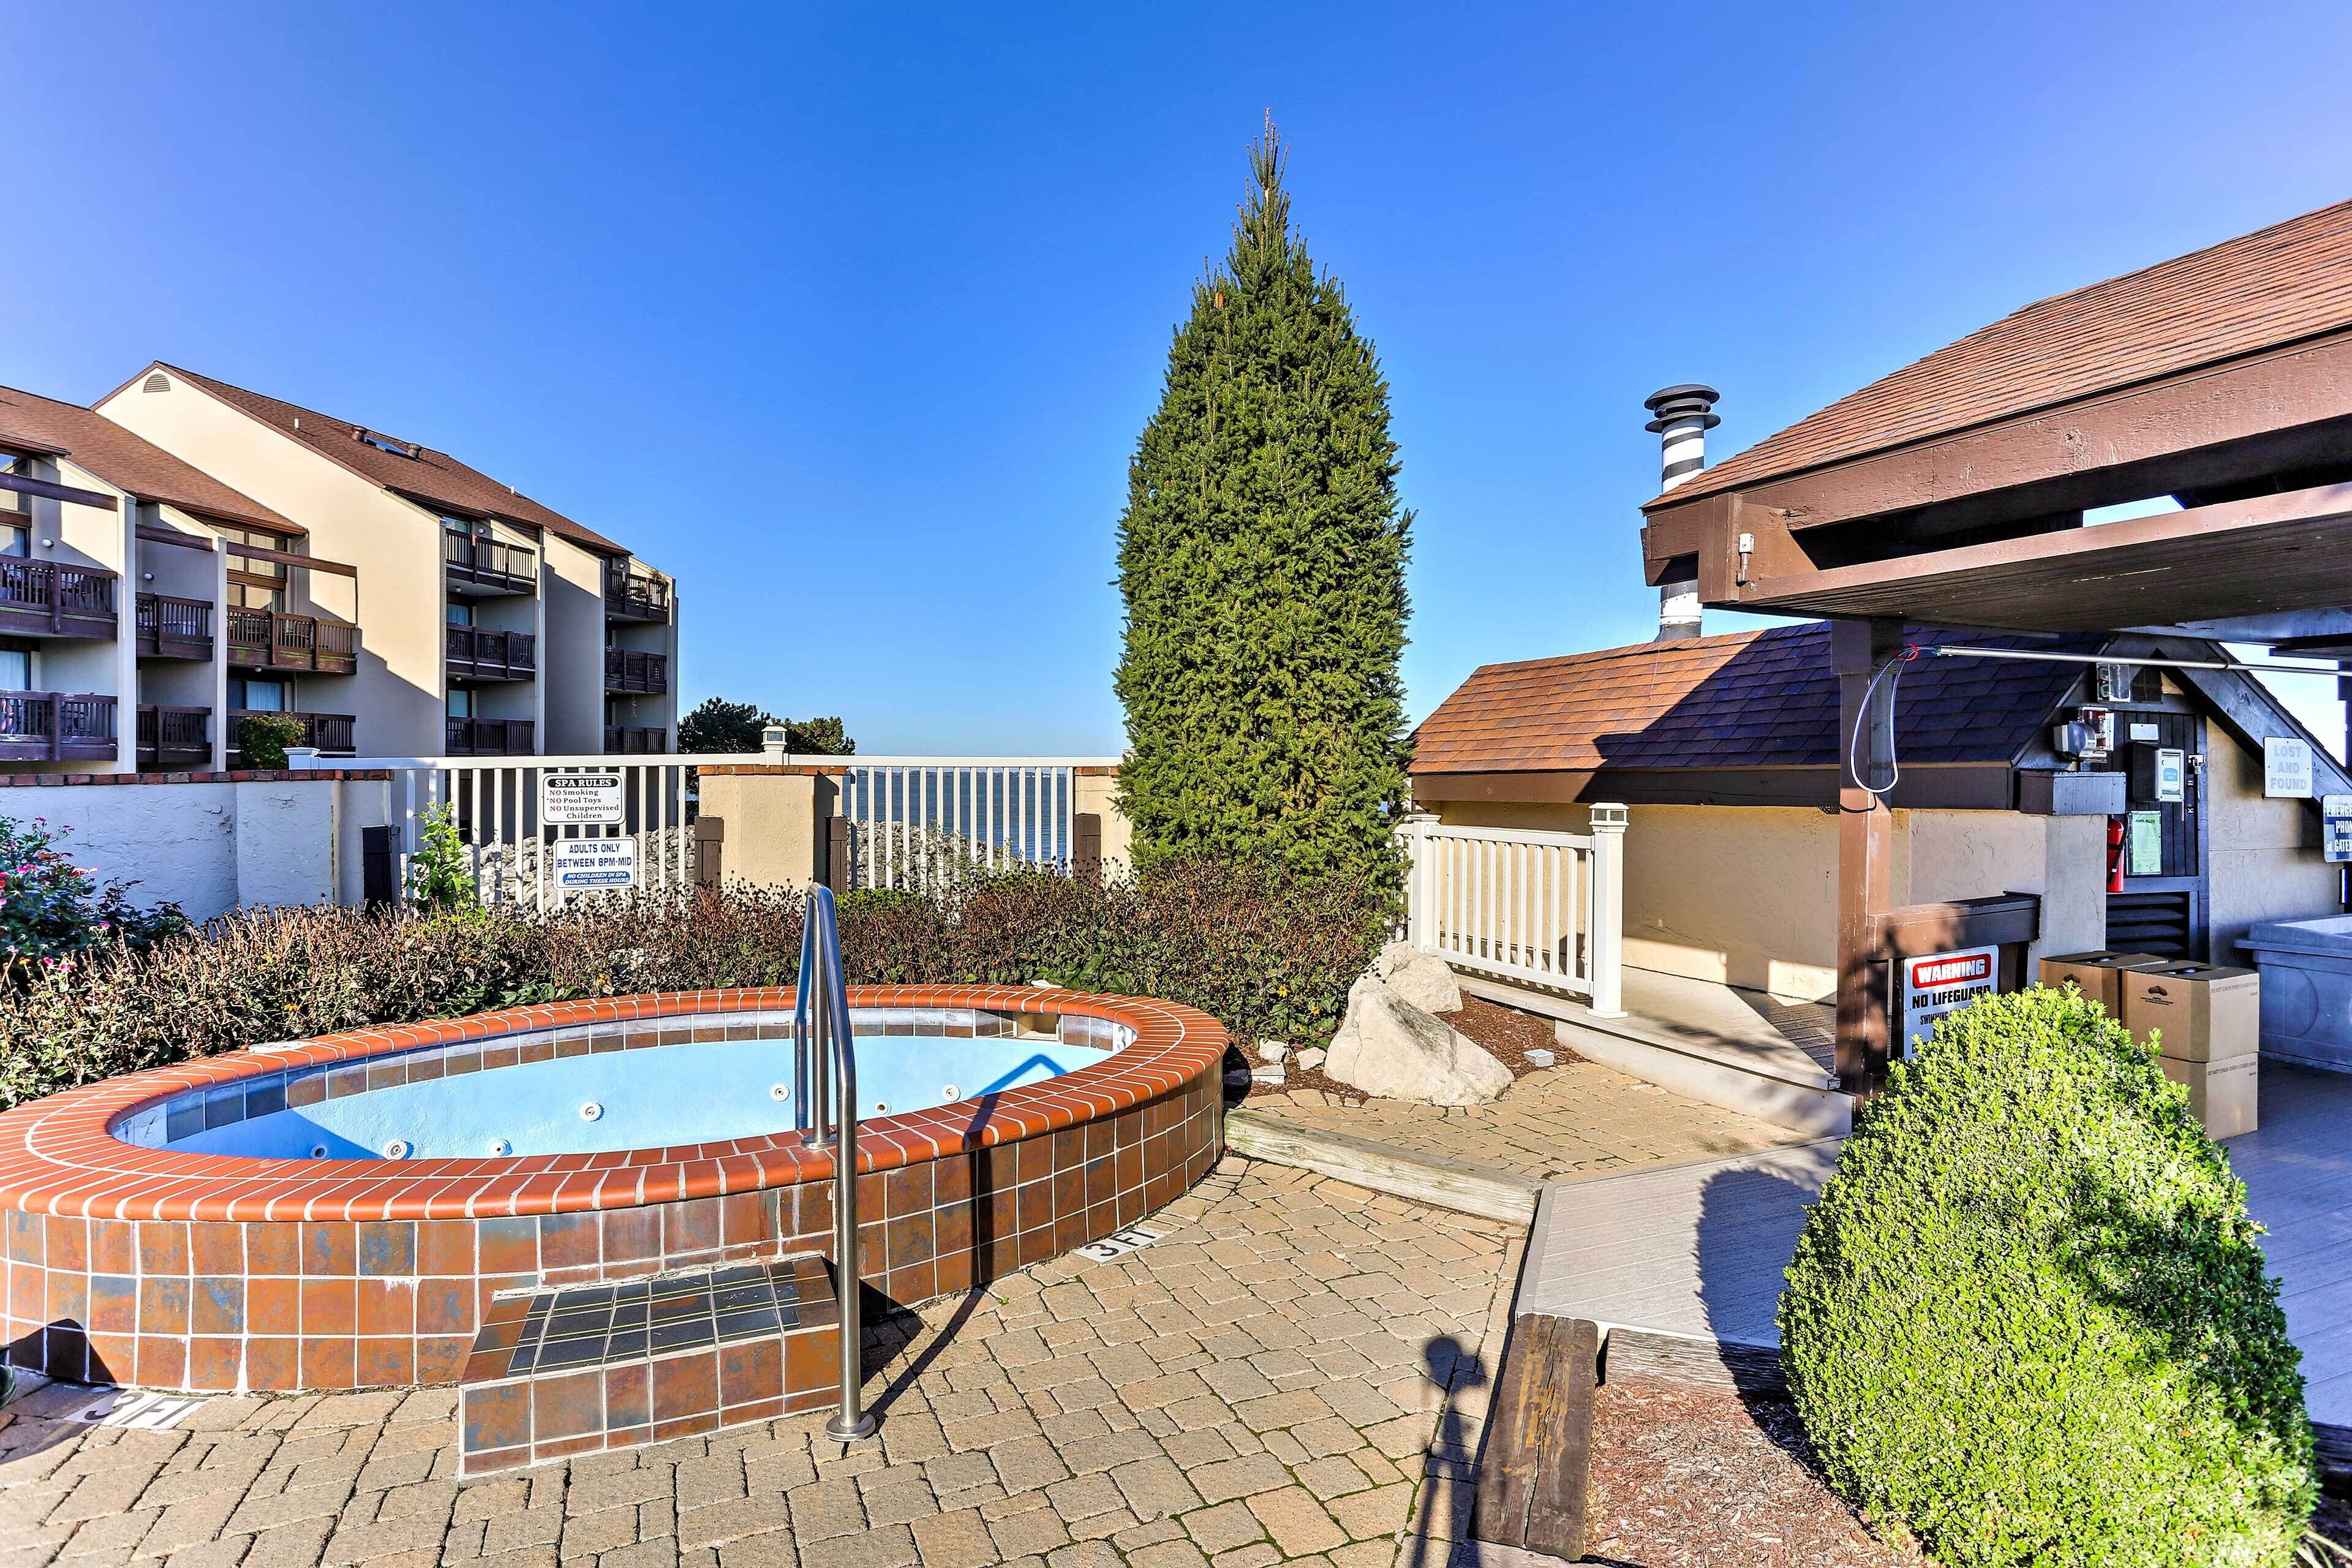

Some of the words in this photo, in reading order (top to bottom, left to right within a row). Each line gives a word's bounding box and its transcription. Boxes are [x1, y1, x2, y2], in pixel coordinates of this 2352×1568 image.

[2274, 745, 2302, 758] LOST
[2277, 762, 2300, 774] AND
[2270, 778, 2307, 790] FOUND
[569, 844, 598, 853] ADULTS
[601, 843, 620, 853] ONLY
[2326, 840, 2333, 852] at
[557, 858, 595, 867] BETWEEN
[598, 857, 631, 867] 8PM-MID
[1917, 959, 1985, 984] WARNING
[1912, 994, 1928, 1009] NO
[1117, 1025, 1126, 1050] 3
[1085, 1243, 1119, 1256] 3
[1109, 1229, 1157, 1246] FT
[85, 1392, 145, 1420] 3
[121, 1396, 209, 1426] FT
